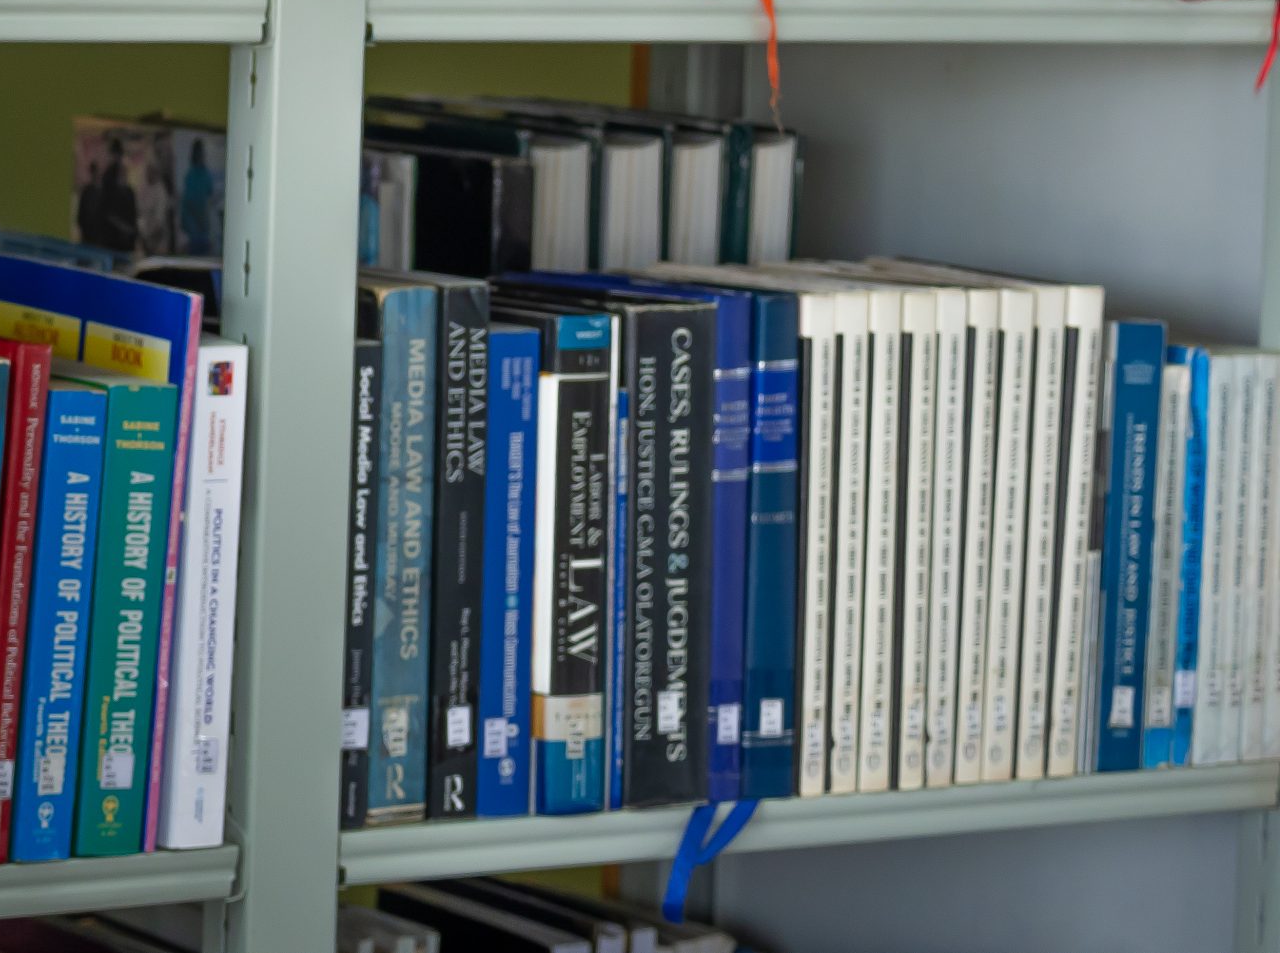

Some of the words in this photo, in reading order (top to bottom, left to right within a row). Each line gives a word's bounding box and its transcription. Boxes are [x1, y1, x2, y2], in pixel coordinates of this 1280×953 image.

[447, 320, 466, 382] AND
[468, 328, 487, 414] MEDIA
[666, 327, 693, 424] CASES,
[358, 366, 374, 420] Social
[407, 338, 426, 426] MEDIA
[638, 356, 656, 416] HON.
[52, 433, 100, 445] THORSON
[59, 415, 96, 426] SABINE
[115, 439, 165, 450] THORSON
[122, 419, 161, 431] SABINE
[388, 402, 402, 469] MOORE
[445, 387, 465, 484] ETHICS
[467, 420, 486, 476] LAW
[20, 417, 39, 489] Personality
[67, 471, 90, 485] A
[130, 471, 155, 485] A
[356, 425, 373, 482] Media
[404, 434, 424, 493] LAW
[570, 410, 591, 547] EMPLOYMENT
[636, 420, 656, 510] JUSTICE
[18, 493, 31, 518] and
[355, 488, 371, 528] Law
[387, 476, 401, 516] AND
[588, 453, 606, 521] LABOR
[667, 428, 691, 549] RULINGS
[16, 521, 29, 541] the
[60, 492, 89, 570] HISTORY
[123, 491, 154, 570] HISTORY
[210, 508, 224, 565] POLITICS
[354, 533, 369, 569] and
[403, 501, 422, 558] AND
[587, 526, 604, 547] &
[7, 545, 27, 626] Foundations
[120, 577, 147, 602] OF
[385, 521, 399, 602] MURRAY
[667, 553, 689, 574] &
[57, 578, 81, 603] OF
[351, 575, 369, 627] Ethics
[400, 566, 420, 661] ETHICS
[567, 554, 605, 663] LAW
[7, 629, 20, 644] of
[50, 610, 78, 703] POLITICAL
[113, 608, 143, 701] POLITICAL
[205, 598, 219, 671] CHANGING
[634, 582, 654, 741] OLATOREGUN
[2, 647, 18, 699] Political
[203, 674, 216, 725] WORLD
[46, 712, 70, 756] THEO
[109, 709, 136, 755] THEO
